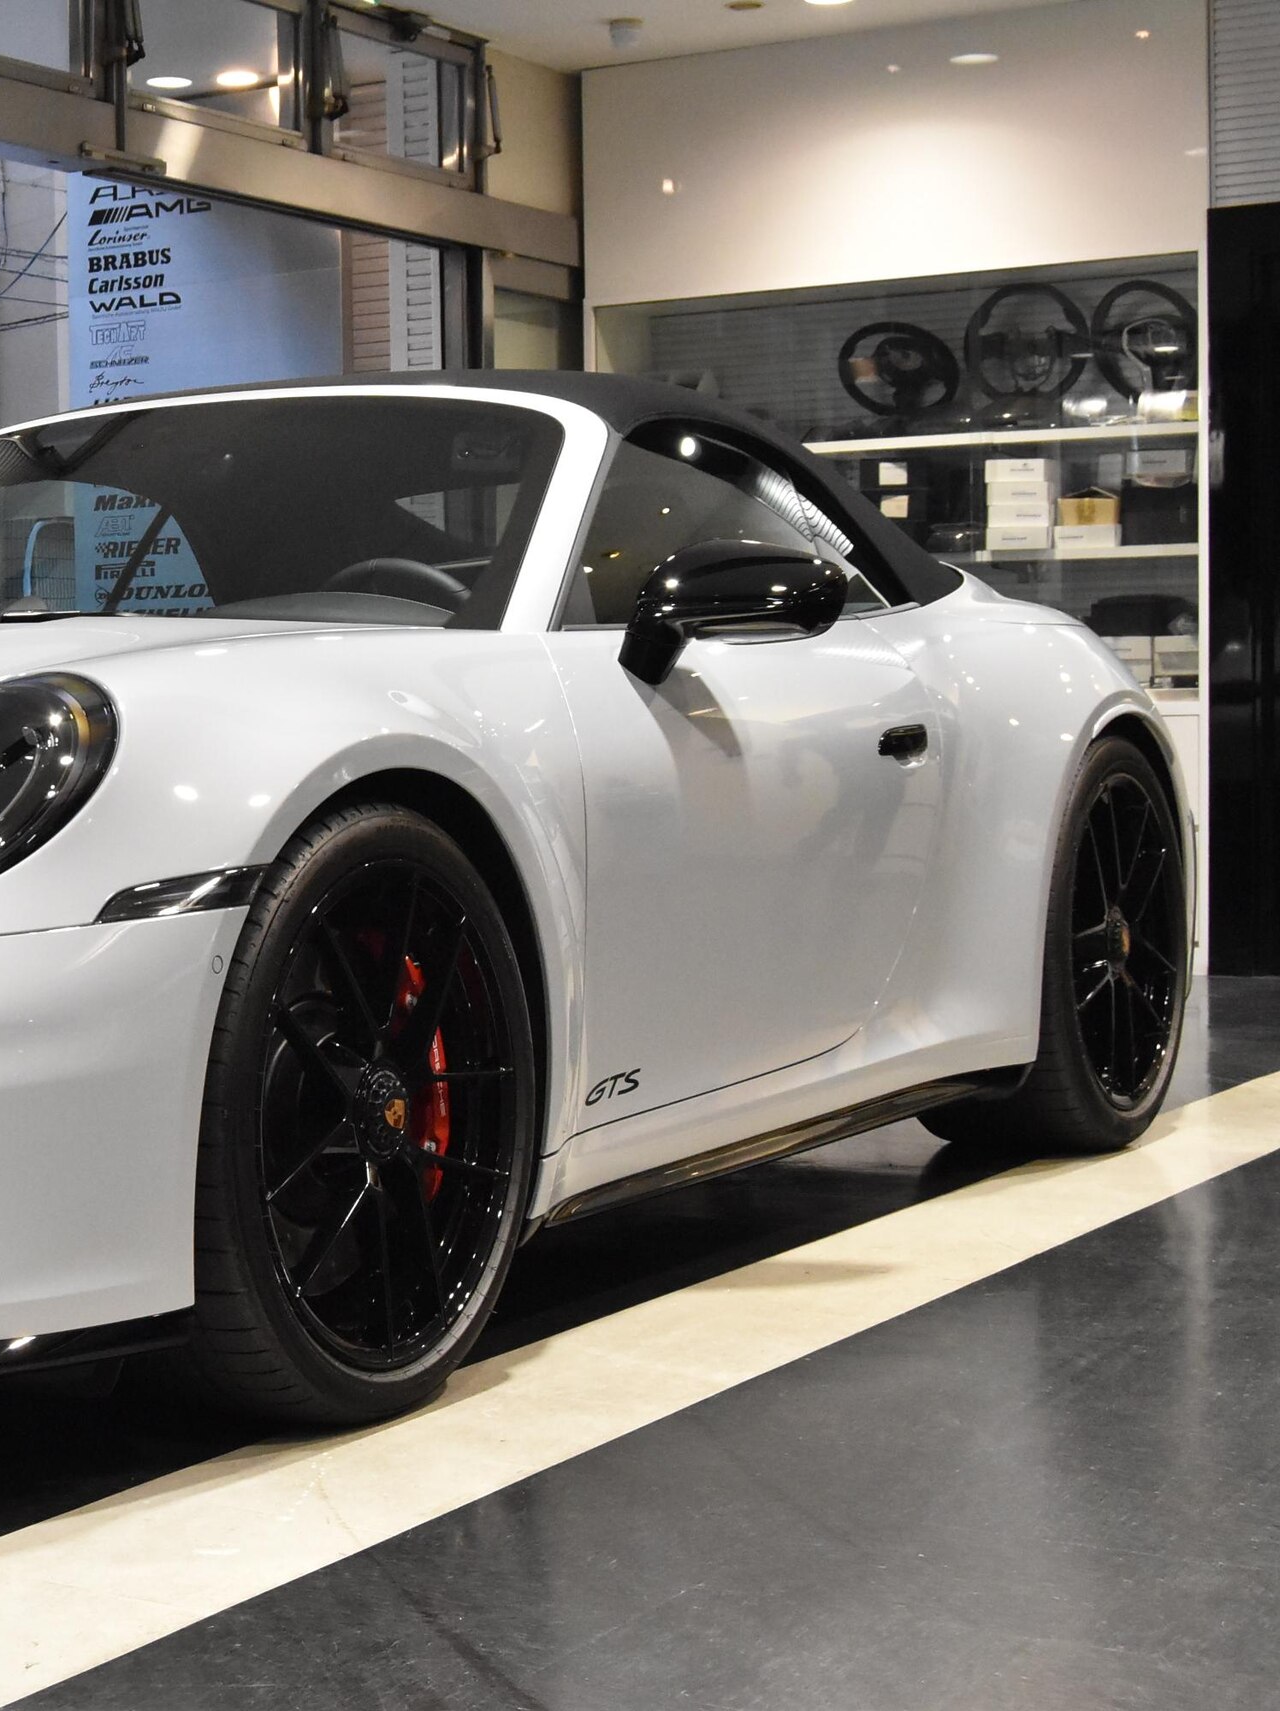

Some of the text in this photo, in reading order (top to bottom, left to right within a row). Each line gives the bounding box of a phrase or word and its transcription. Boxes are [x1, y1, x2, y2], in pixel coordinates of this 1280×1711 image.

[124, 198, 211, 222] AMG
[88, 230, 149, 247] Lorinser
[88, 248, 171, 273] BRABUS
[88, 274, 165, 294] Carlsson
[89, 292, 182, 313] WALD
[103, 538, 181, 558] RIEER
[119, 583, 213, 601] DUNLO
[585, 1068, 641, 1106] GTS
